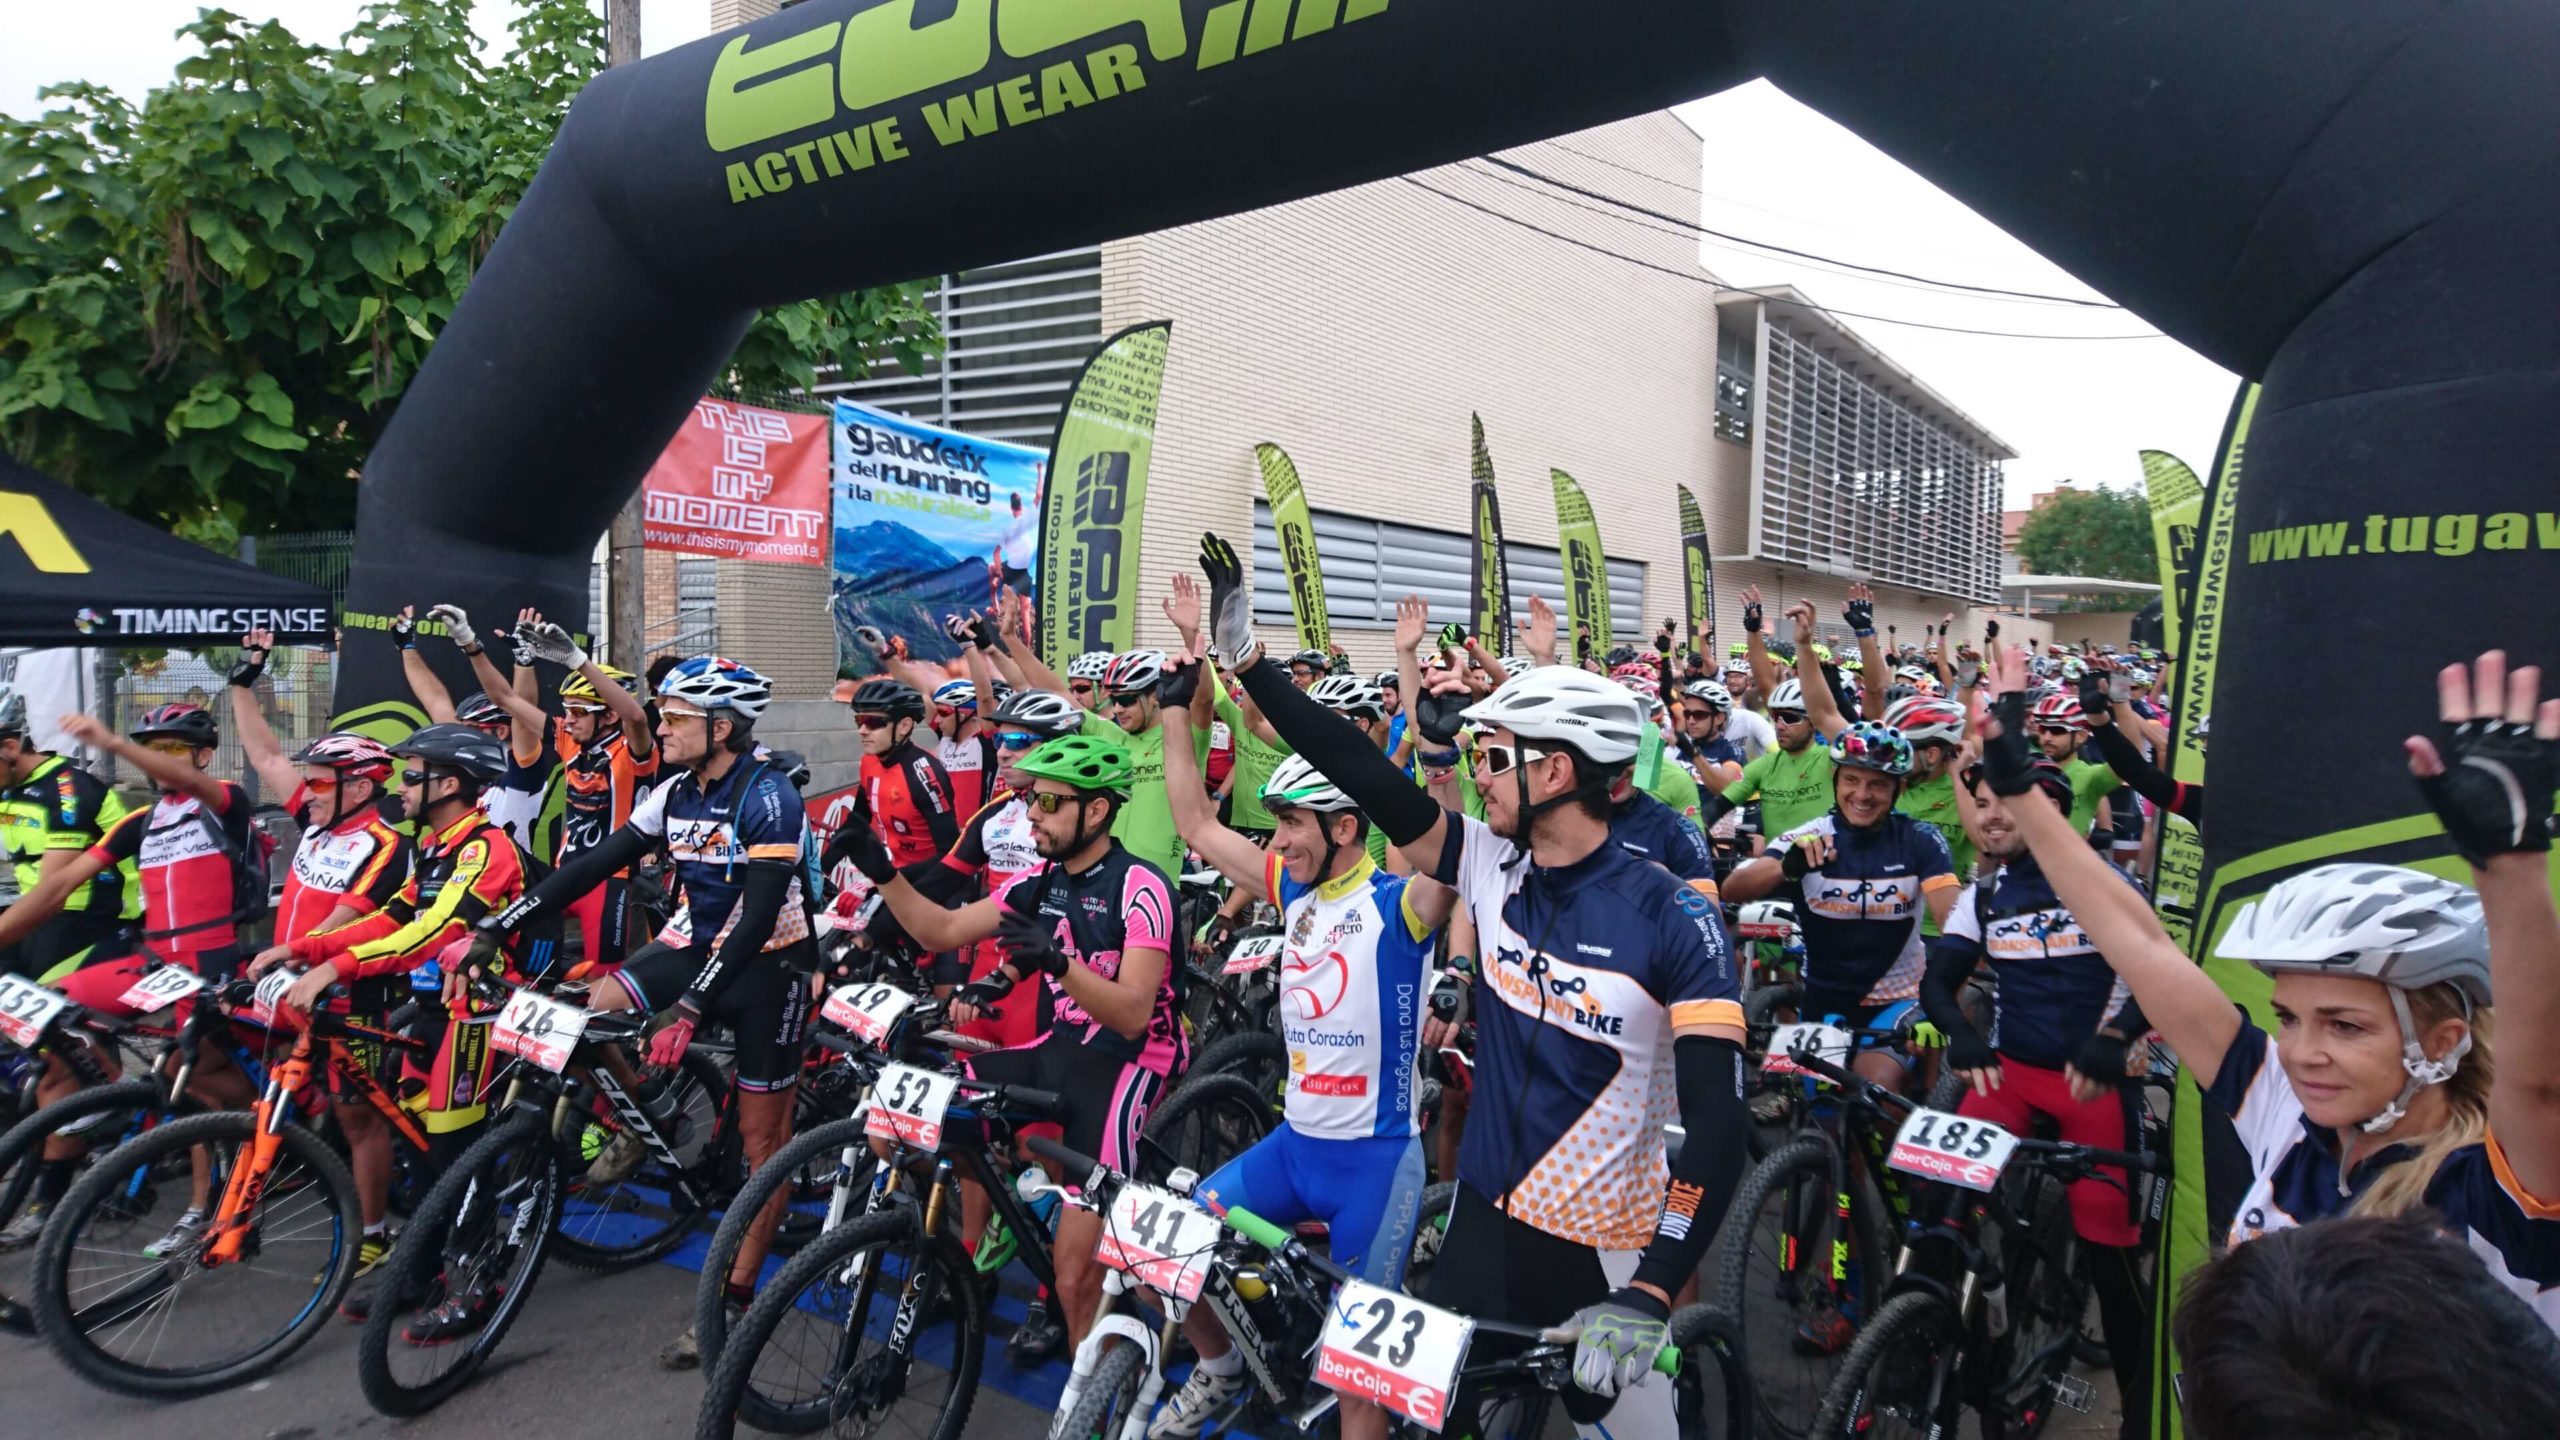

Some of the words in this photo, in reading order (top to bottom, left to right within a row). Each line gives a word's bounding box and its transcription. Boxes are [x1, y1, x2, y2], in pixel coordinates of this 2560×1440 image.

[724, 117, 910, 203] ACTIVE
[921, 43, 1146, 146] WEAR
[695, 401, 793, 443] THIS
[723, 433, 767, 470] IS
[847, 422, 989, 476] gaudeix
[713, 465, 774, 501] MY
[849, 460, 878, 479] del
[880, 463, 991, 505] running
[644, 490, 824, 539] MOMENT
[874, 489, 992, 522] naturalesa
[1555, 717, 1590, 728] catlike
[1242, 939, 1271, 958] 30
[138, 968, 191, 995] 159
[846, 984, 892, 1013] 19
[515, 1000, 558, 1038] 26
[826, 1001, 861, 1027] iberCaja
[1397, 984, 1413, 1027] Dona
[1308, 1025, 1364, 1048] Corazón
[1397, 1030, 1412, 1050] tus
[1787, 1027, 1823, 1054] 36
[889, 1072, 932, 1117] 52
[1305, 1076, 1360, 1095] Burgos
[1394, 1053, 1411, 1112] organos
[595, 1067, 682, 1169] SCOTT
[868, 1109, 912, 1137] iberCaja
[1909, 1115, 1999, 1159] 185
[1892, 1147, 1953, 1175] iberCaja
[1132, 1200, 1187, 1258] 41
[1658, 1178, 1704, 1241] UNIBIKE
[1098, 1239, 1158, 1278] iberCaja
[888, 1293, 918, 1355] FOX
[1214, 1275, 1268, 1360] TREK
[1353, 1297, 1426, 1369] 23
[1319, 1351, 1392, 1399] iberCaja
